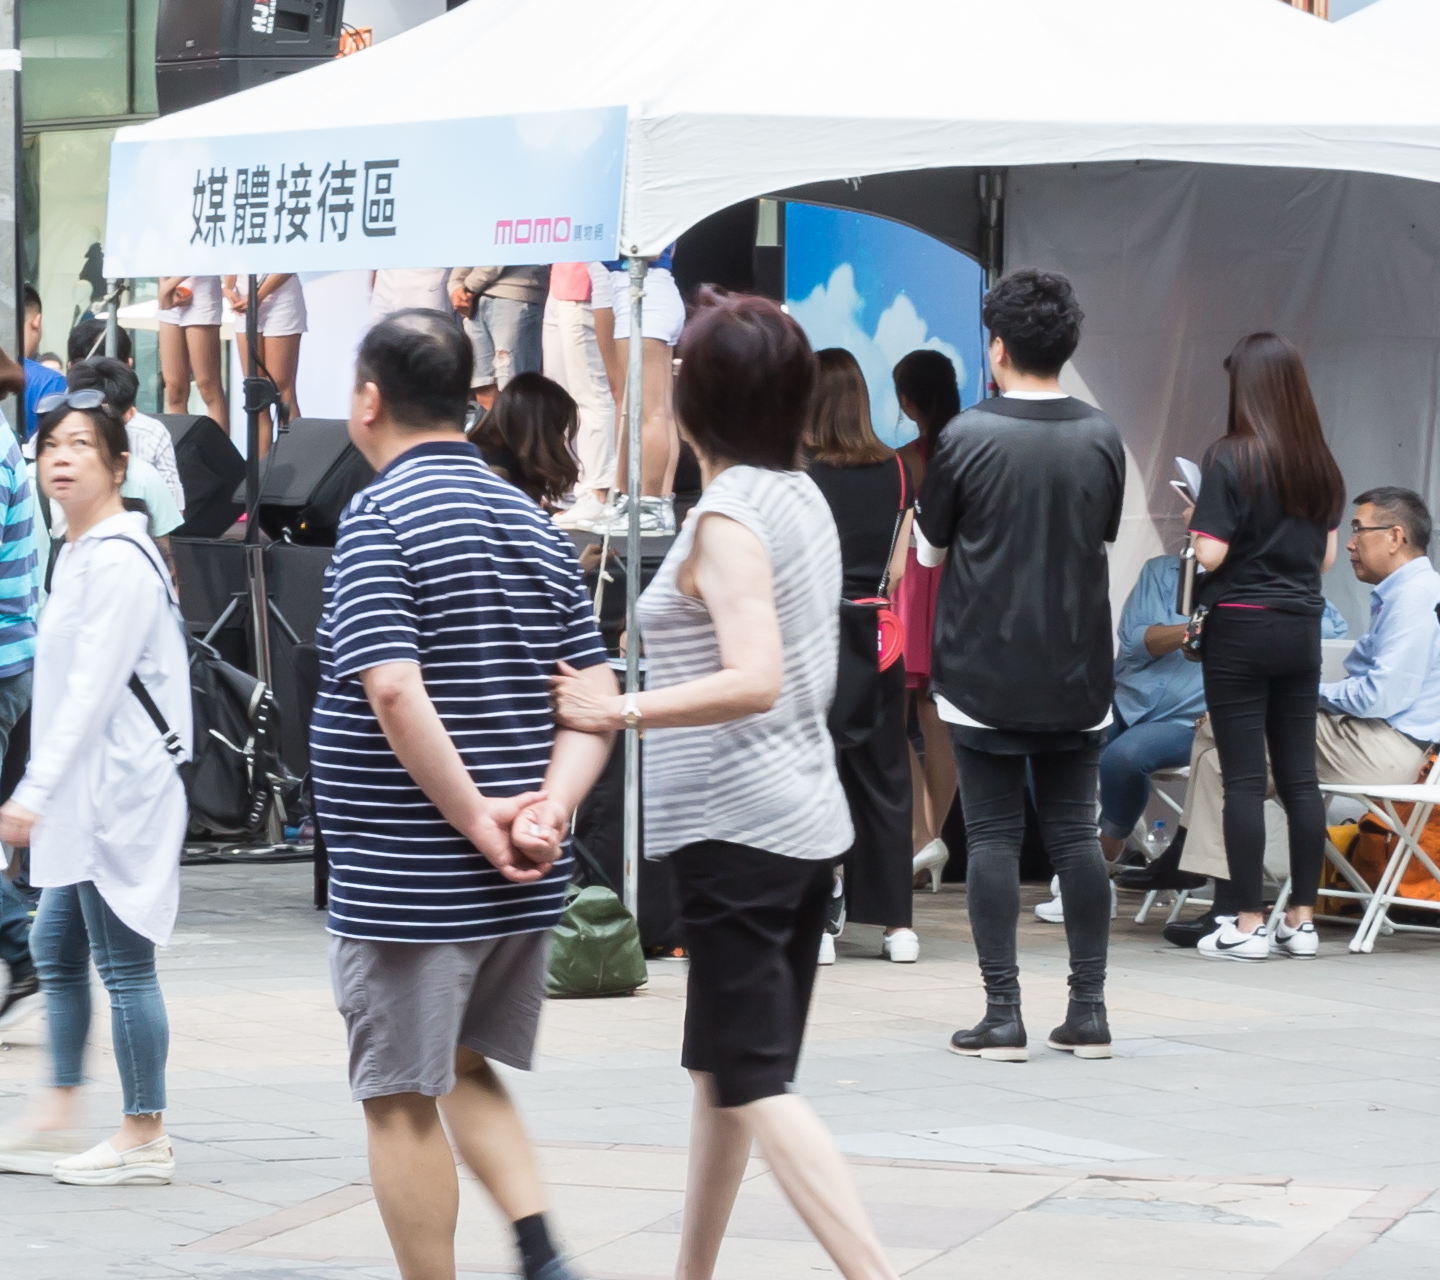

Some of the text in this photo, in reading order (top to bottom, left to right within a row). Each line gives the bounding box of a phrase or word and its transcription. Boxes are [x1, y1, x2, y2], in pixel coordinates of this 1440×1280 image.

[189, 158, 401, 248] 媒體接待區
